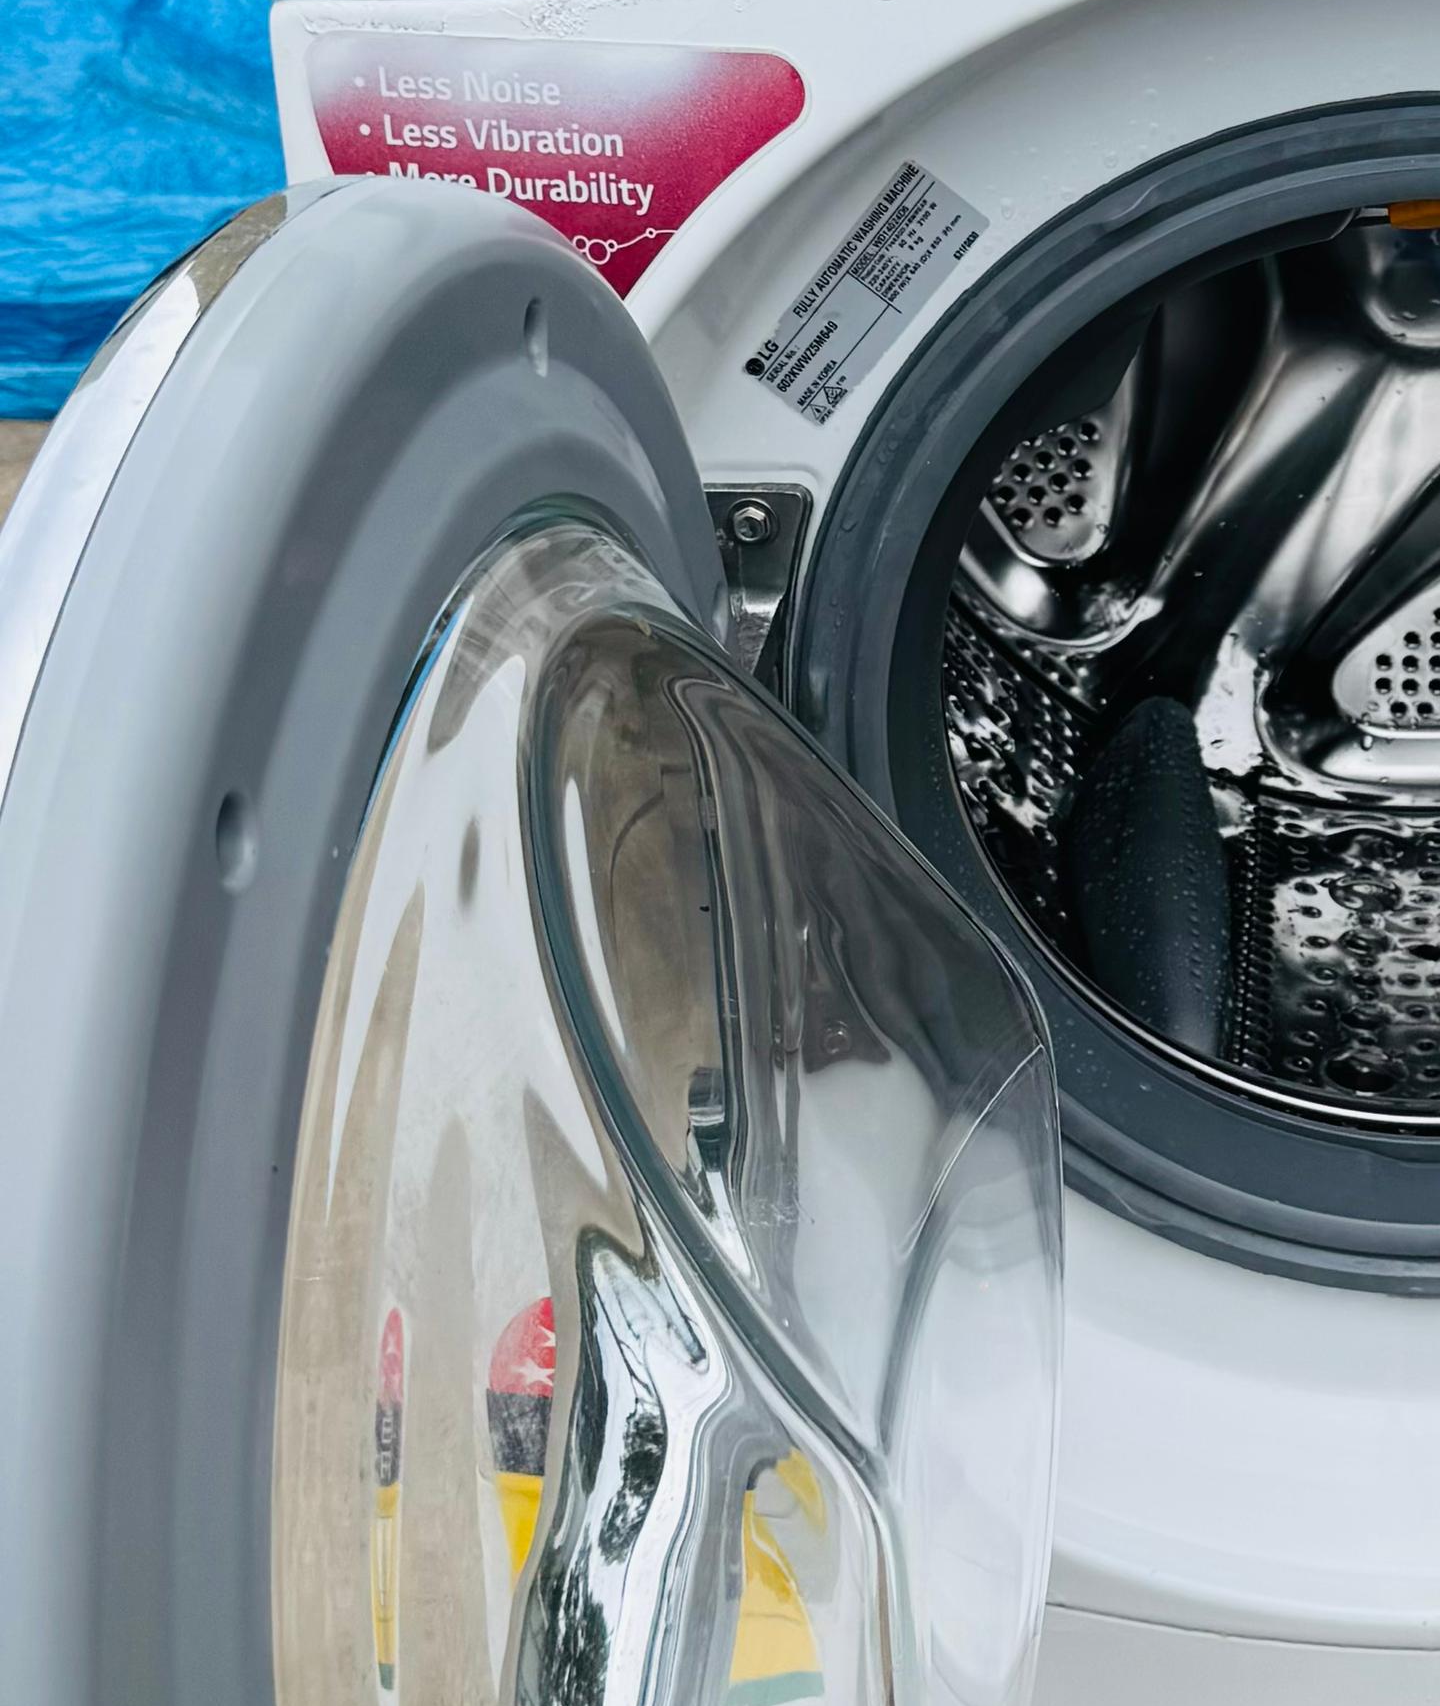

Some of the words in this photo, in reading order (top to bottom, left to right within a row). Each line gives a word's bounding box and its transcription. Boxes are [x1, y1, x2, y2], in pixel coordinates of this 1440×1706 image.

[378, 66, 452, 100] Less
[463, 70, 561, 106] Noise
[384, 115, 456, 149] Less
[464, 118, 624, 158] Vibration
[487, 167, 654, 215] Durability
[791, 287, 821, 318] FULLY
[813, 240, 858, 292] AUTOMATIC
[851, 201, 889, 244] WASHING
[882, 163, 919, 205] MACHINE
[757, 339, 779, 361] LG
